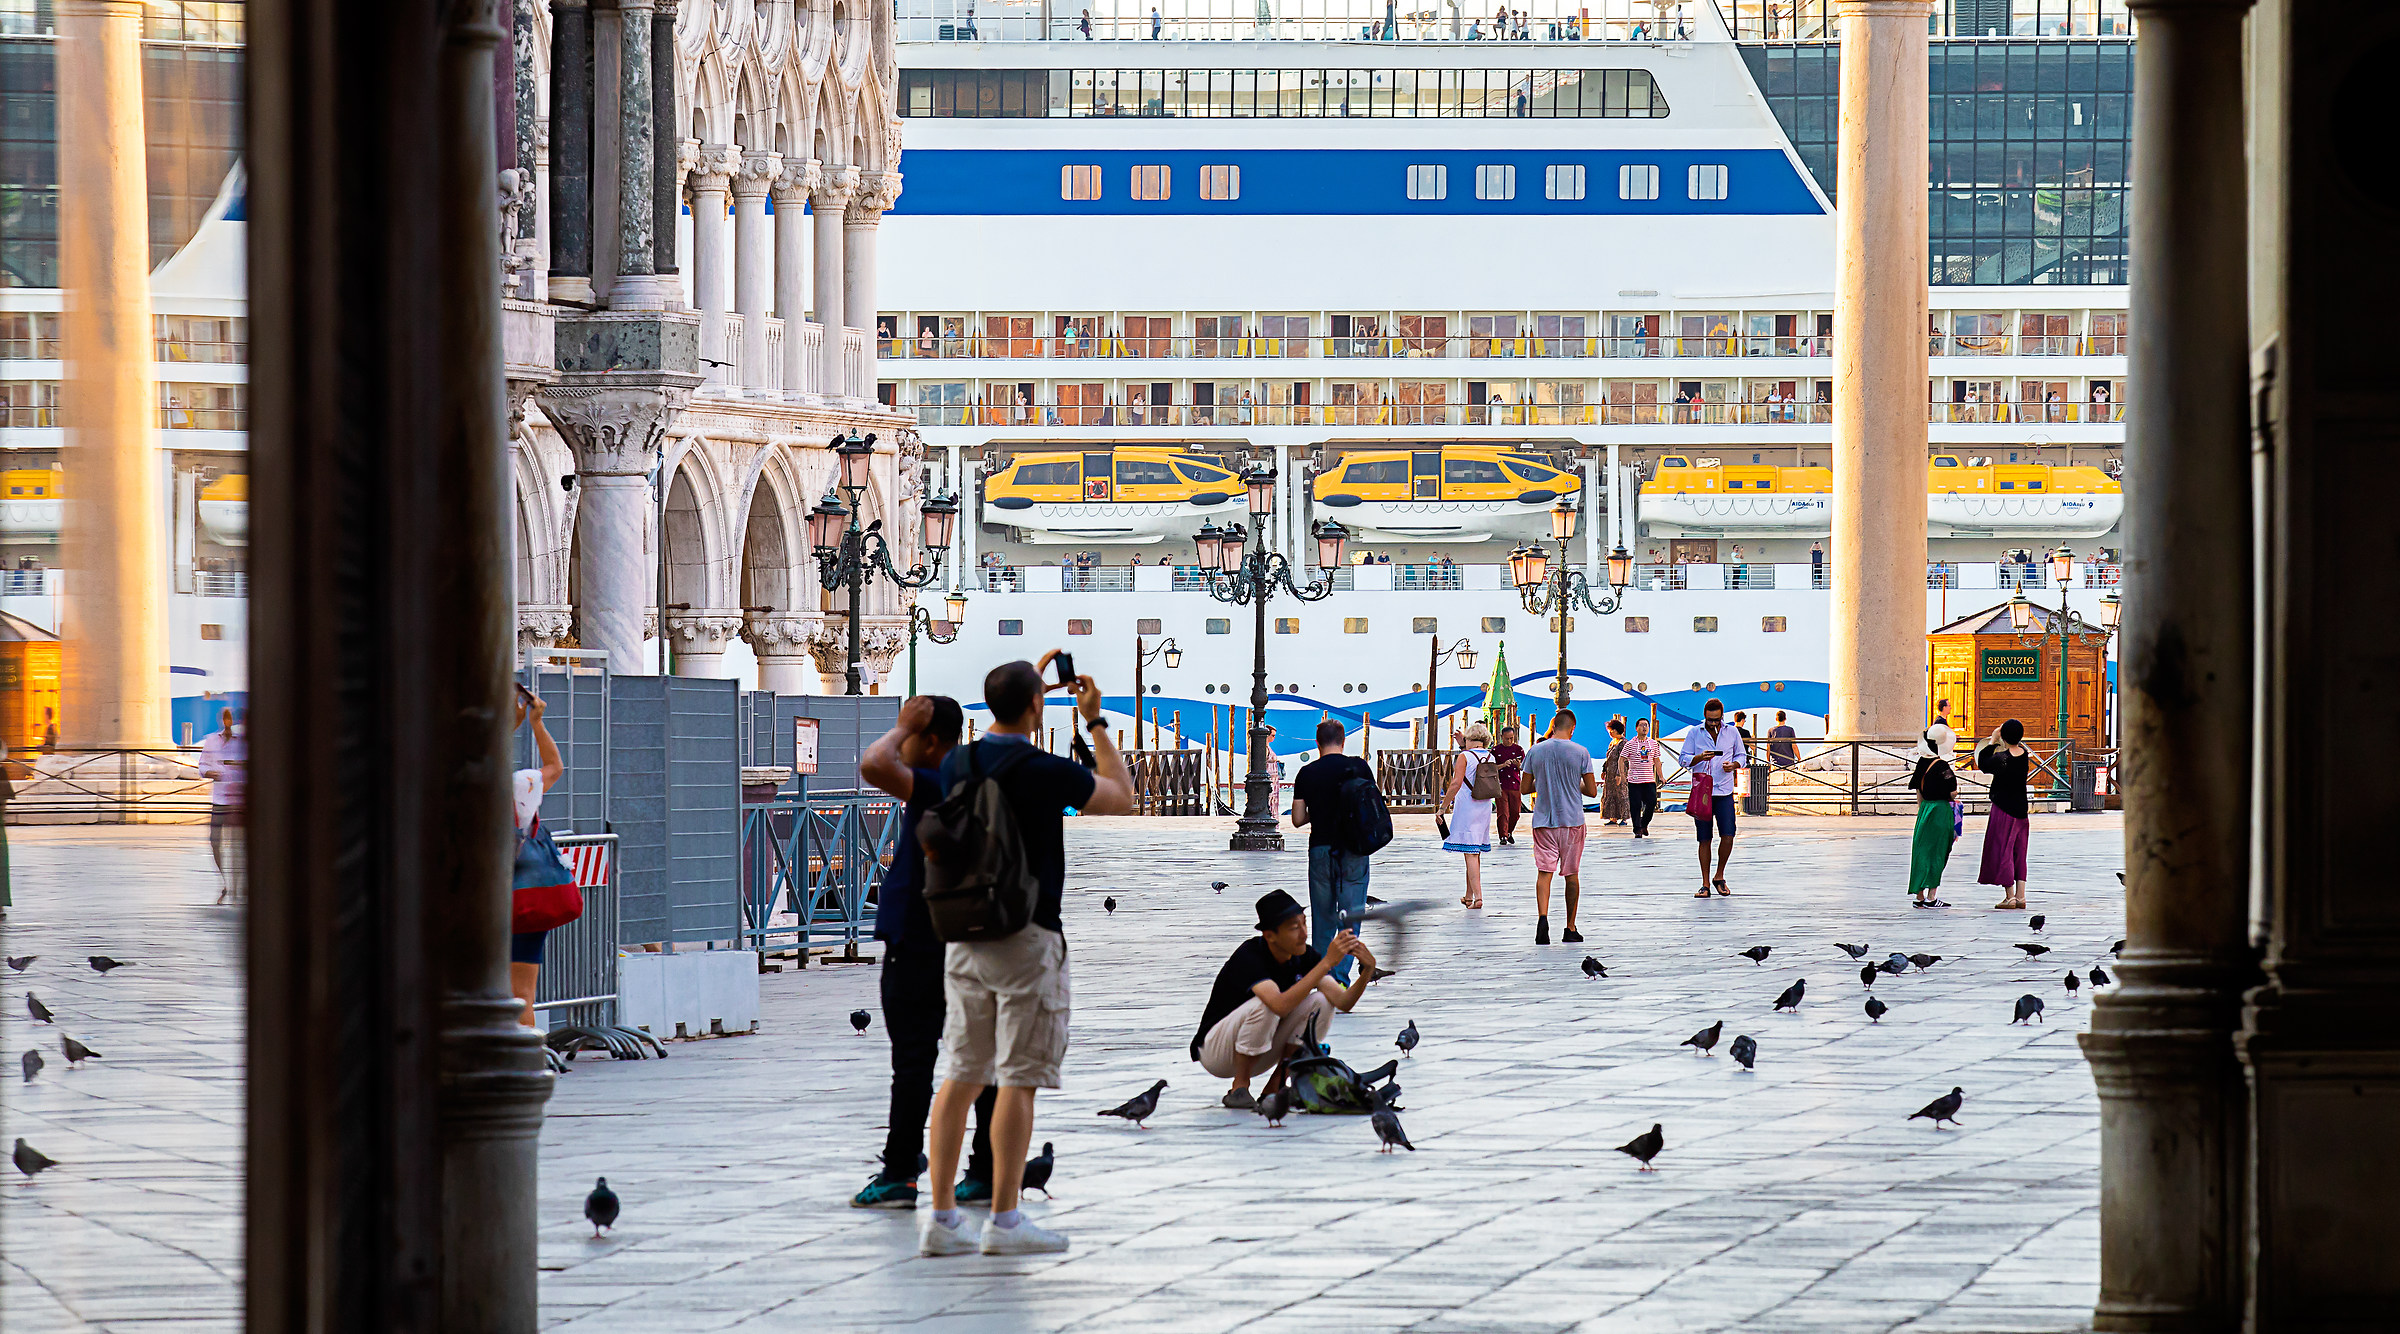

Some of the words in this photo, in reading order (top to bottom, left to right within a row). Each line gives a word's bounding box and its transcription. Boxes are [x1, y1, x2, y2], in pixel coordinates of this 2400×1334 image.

[1816, 501, 1824, 509] 11
[2088, 501, 2094, 509] 9
[1987, 656, 2035, 665] SERVIZIO
[1986, 666, 2035, 675] GONDOLE
